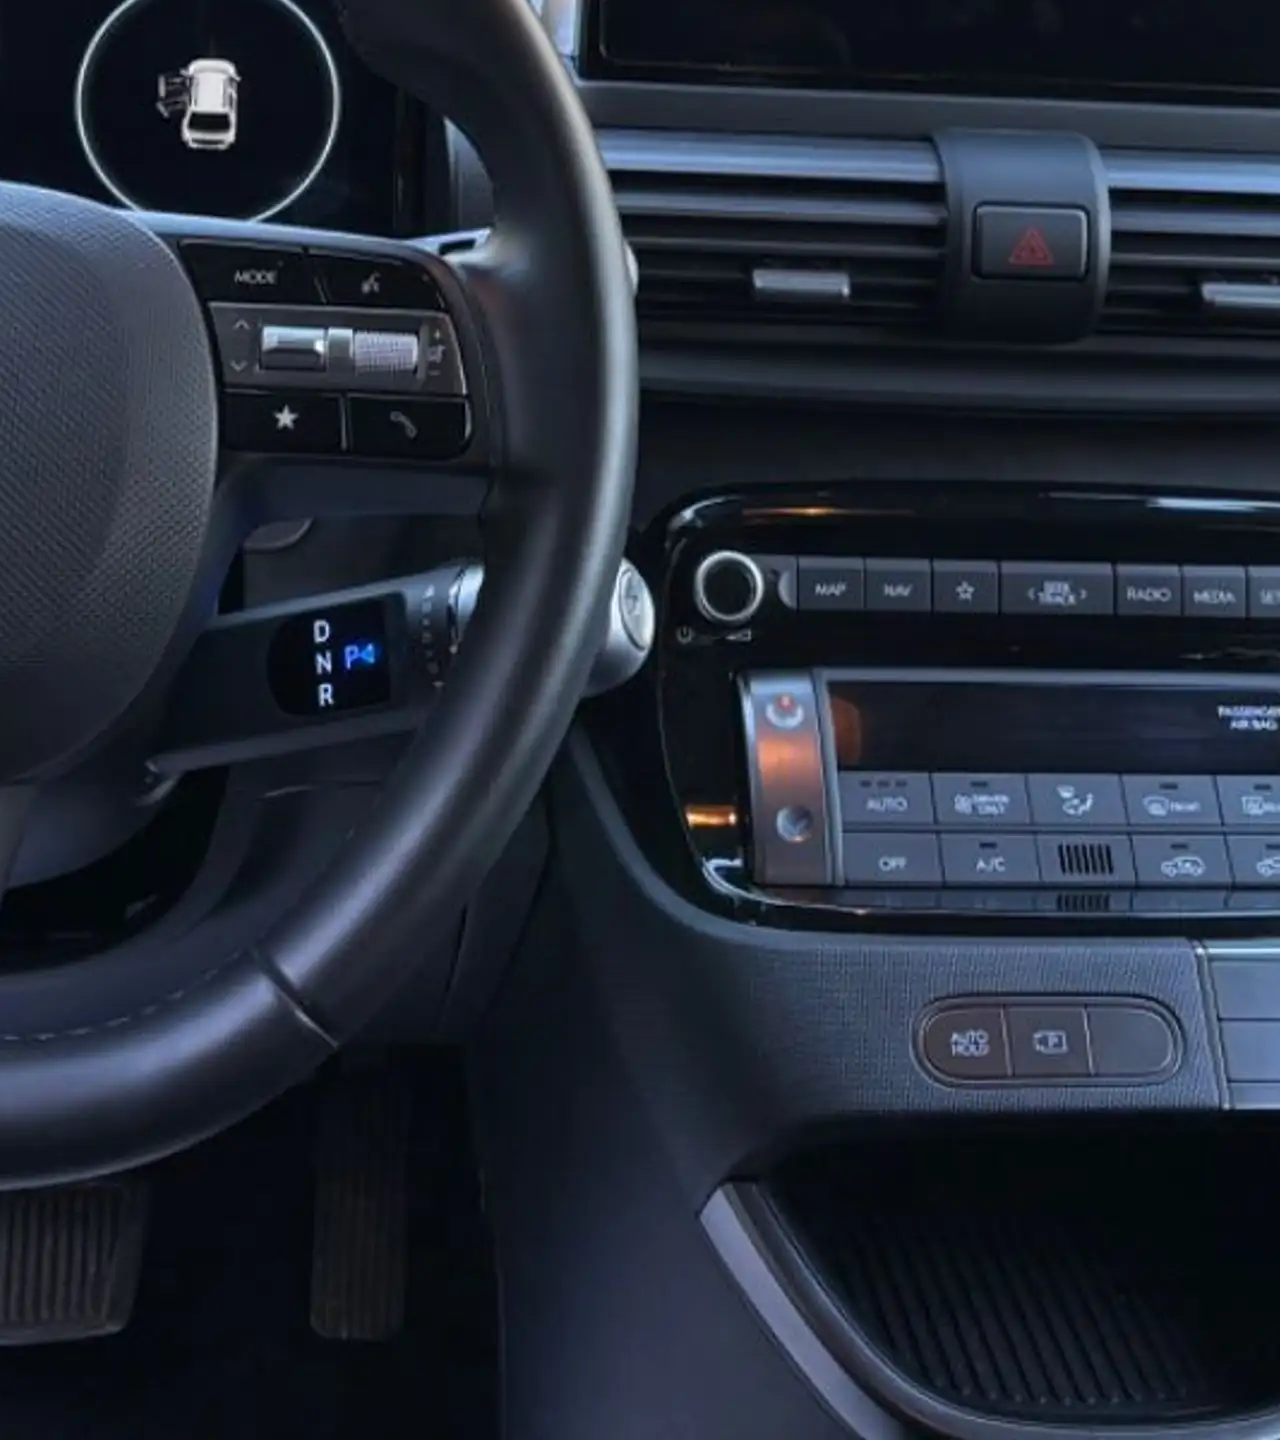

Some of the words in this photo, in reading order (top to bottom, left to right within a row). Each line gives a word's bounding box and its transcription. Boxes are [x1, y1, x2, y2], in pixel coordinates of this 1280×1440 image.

[233, 270, 278, 287] MODE
[815, 583, 847, 597] MAP
[883, 583, 913, 598] NAV
[1126, 587, 1171, 603] RADIO
[1194, 591, 1236, 605] MEDIA
[313, 620, 330, 644] D
[316, 650, 332, 675] N
[344, 645, 360, 670] P
[318, 683, 334, 707] R
[867, 798, 908, 812] AUTO
[878, 857, 907, 871] OFF
[975, 857, 1006, 872] A/C
[951, 1029, 989, 1044] AUTO
[951, 1043, 991, 1057] HOLD
